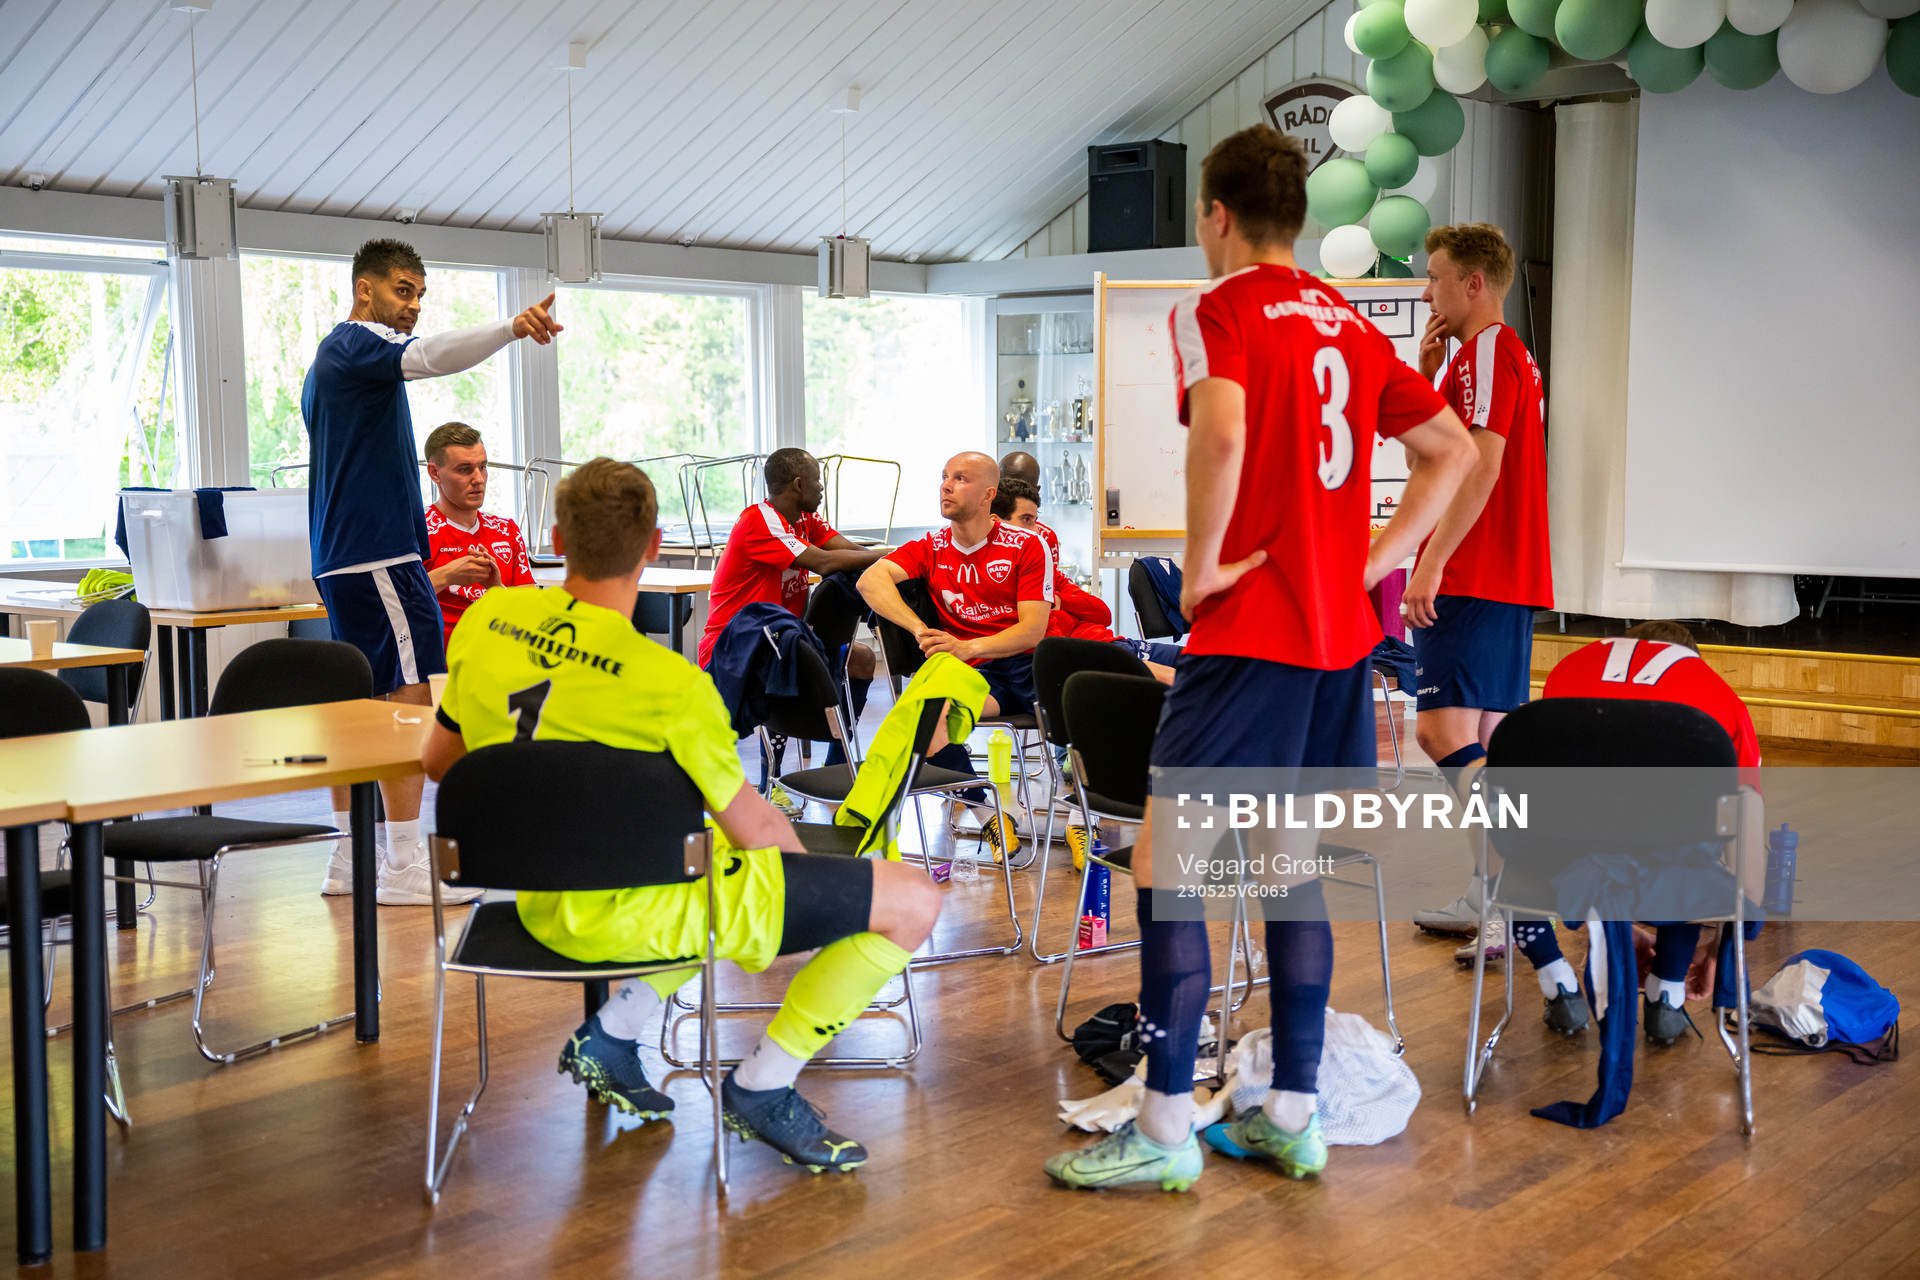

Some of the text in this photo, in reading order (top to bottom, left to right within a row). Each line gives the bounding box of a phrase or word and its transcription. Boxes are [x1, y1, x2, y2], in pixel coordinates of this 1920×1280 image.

[1303, 138, 1320, 154] IL
[1312, 346, 1354, 490] 3
[989, 563, 1010, 574] RÅDE
[996, 571, 1004, 579] IL
[488, 616, 625, 678] GUMMISERVICE
[1599, 636, 1701, 686] 17
[507, 677, 552, 742] 1
